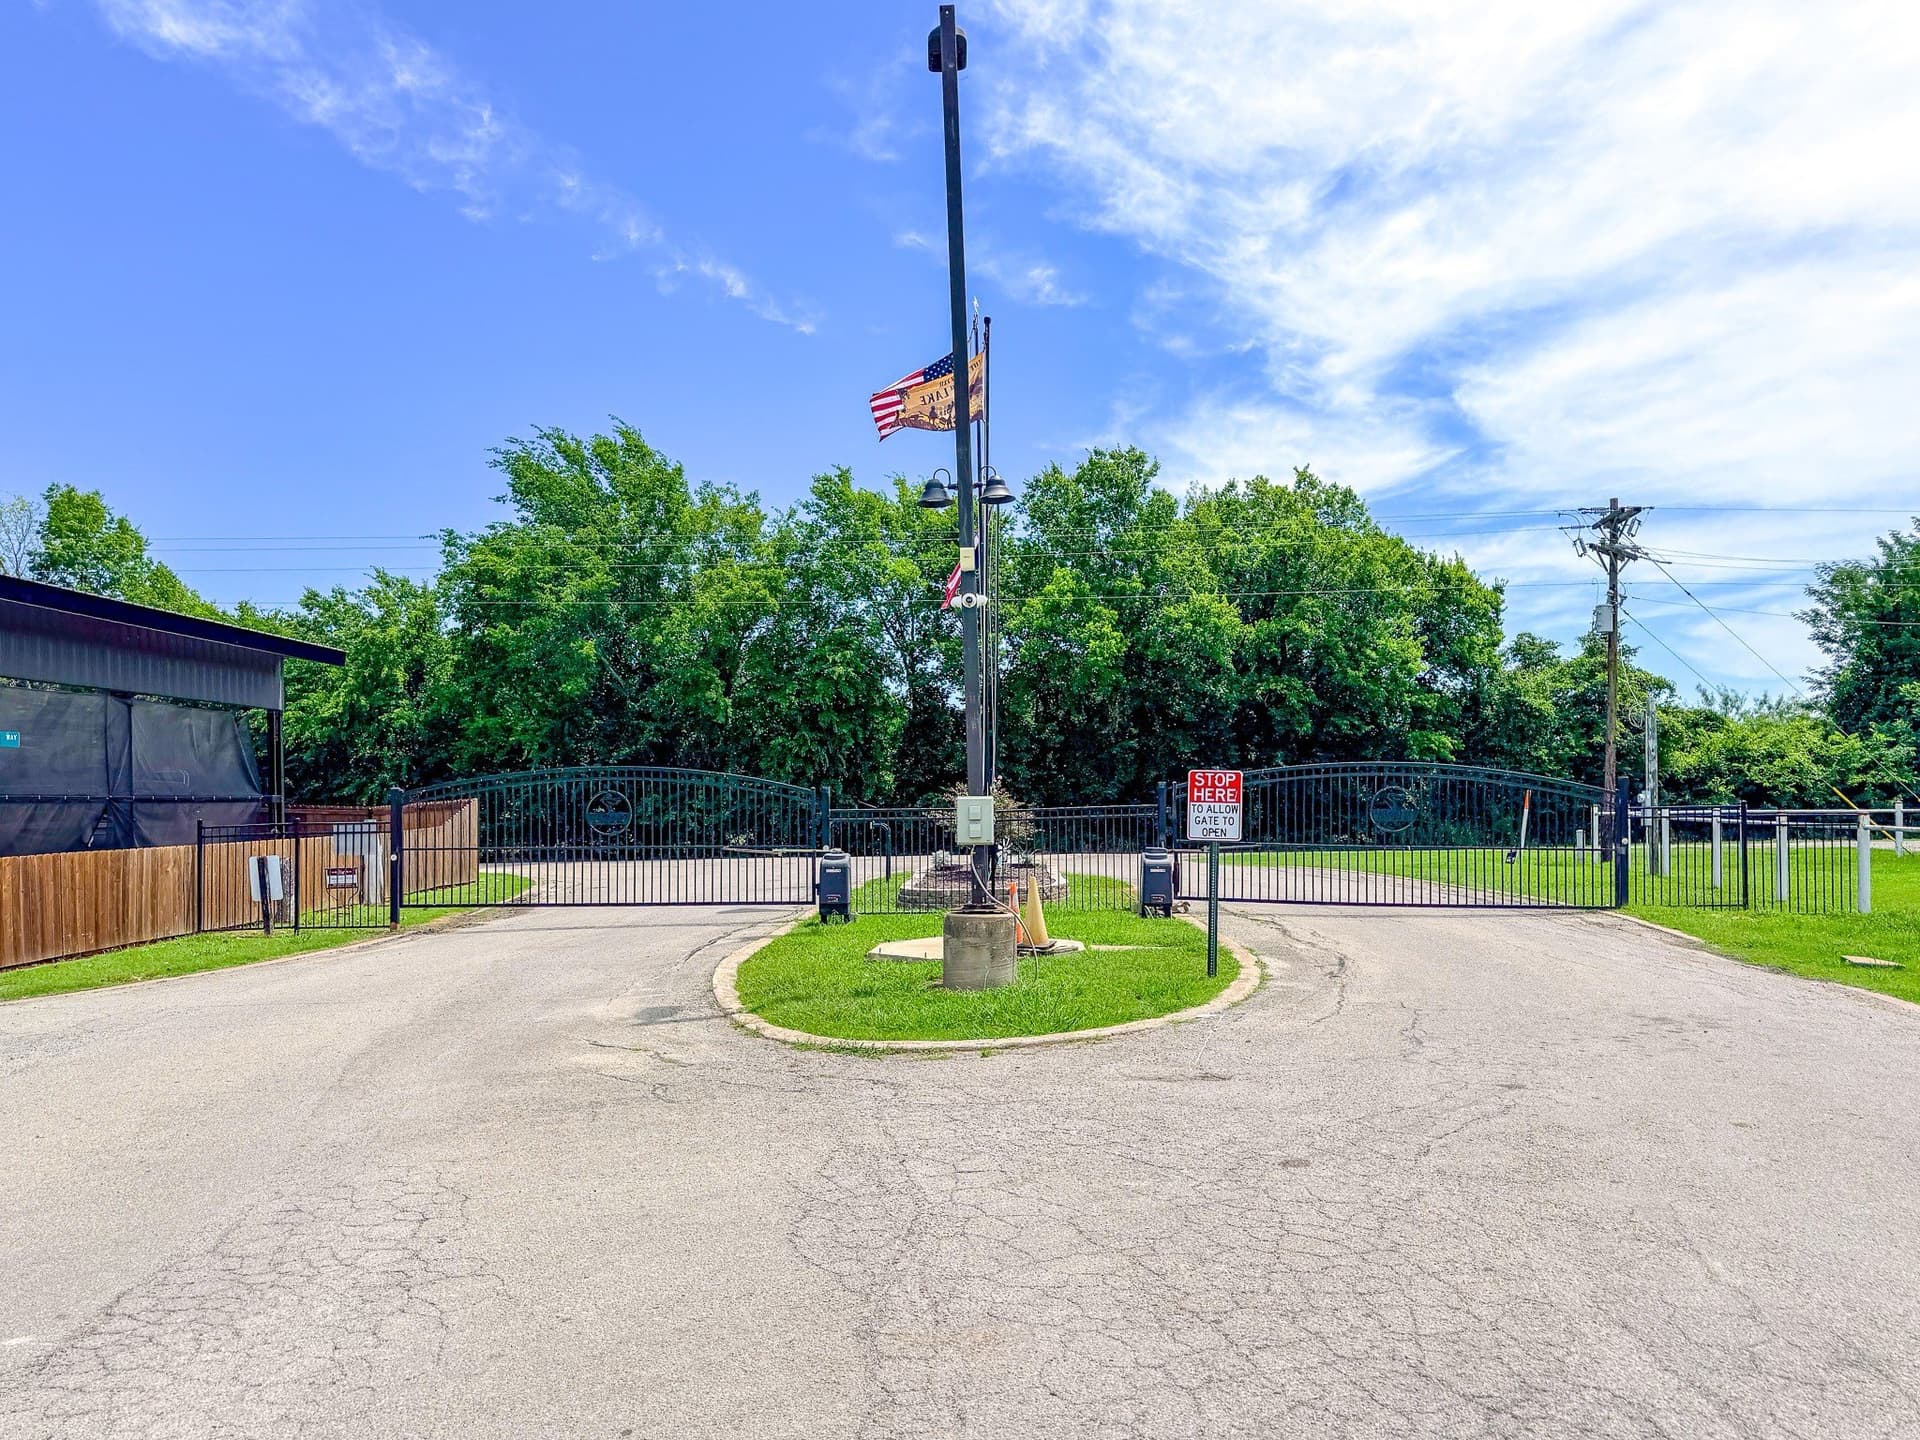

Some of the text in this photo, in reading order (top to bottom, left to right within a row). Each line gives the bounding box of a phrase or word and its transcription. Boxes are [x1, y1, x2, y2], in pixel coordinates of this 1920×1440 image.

[1195, 773, 1236, 787] STOP
[1193, 788, 1236, 802] HERE
[1191, 804, 1239, 814] TO ALLOW
[1194, 816, 1235, 826] GATE TO
[1201, 828, 1227, 837] OPEN
